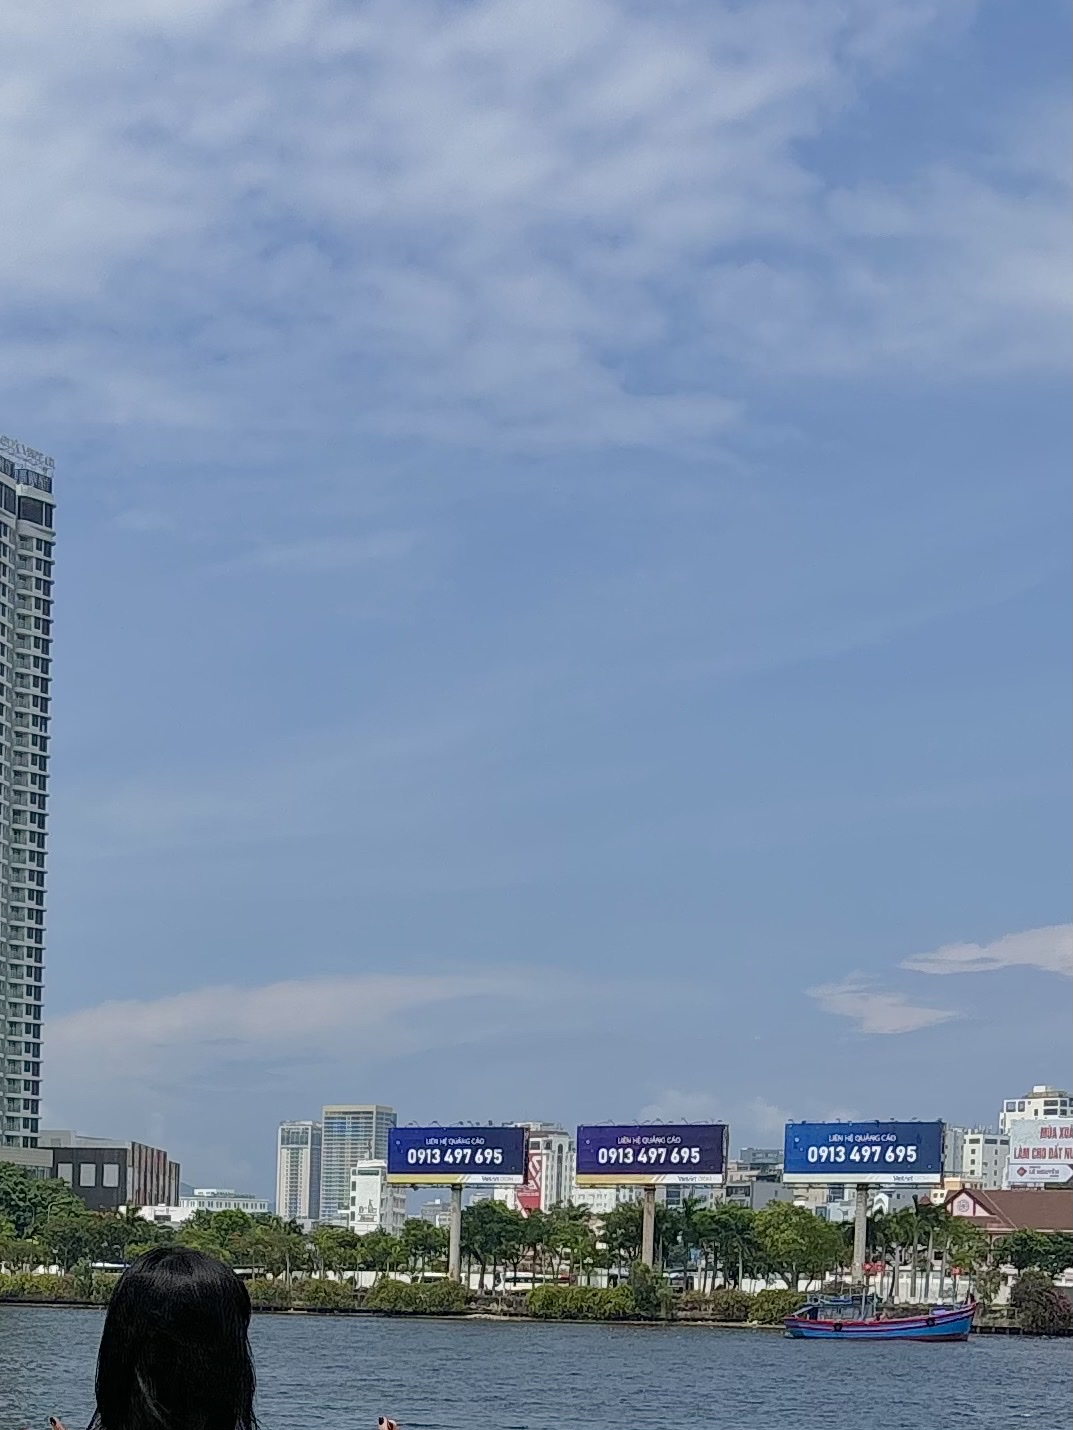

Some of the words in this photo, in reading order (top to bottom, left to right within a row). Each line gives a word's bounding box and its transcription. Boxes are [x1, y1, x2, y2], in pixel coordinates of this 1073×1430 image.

[407, 1149, 440, 1164] 0913
[444, 1149, 471, 1164] 497
[475, 1149, 502, 1164] 695
[598, 1148, 633, 1163] 0913
[638, 1148, 667, 1163] 497
[671, 1148, 700, 1163] 695
[808, 1147, 845, 1162] 0913
[850, 1146, 881, 1162] 497
[885, 1146, 917, 1162] 695
